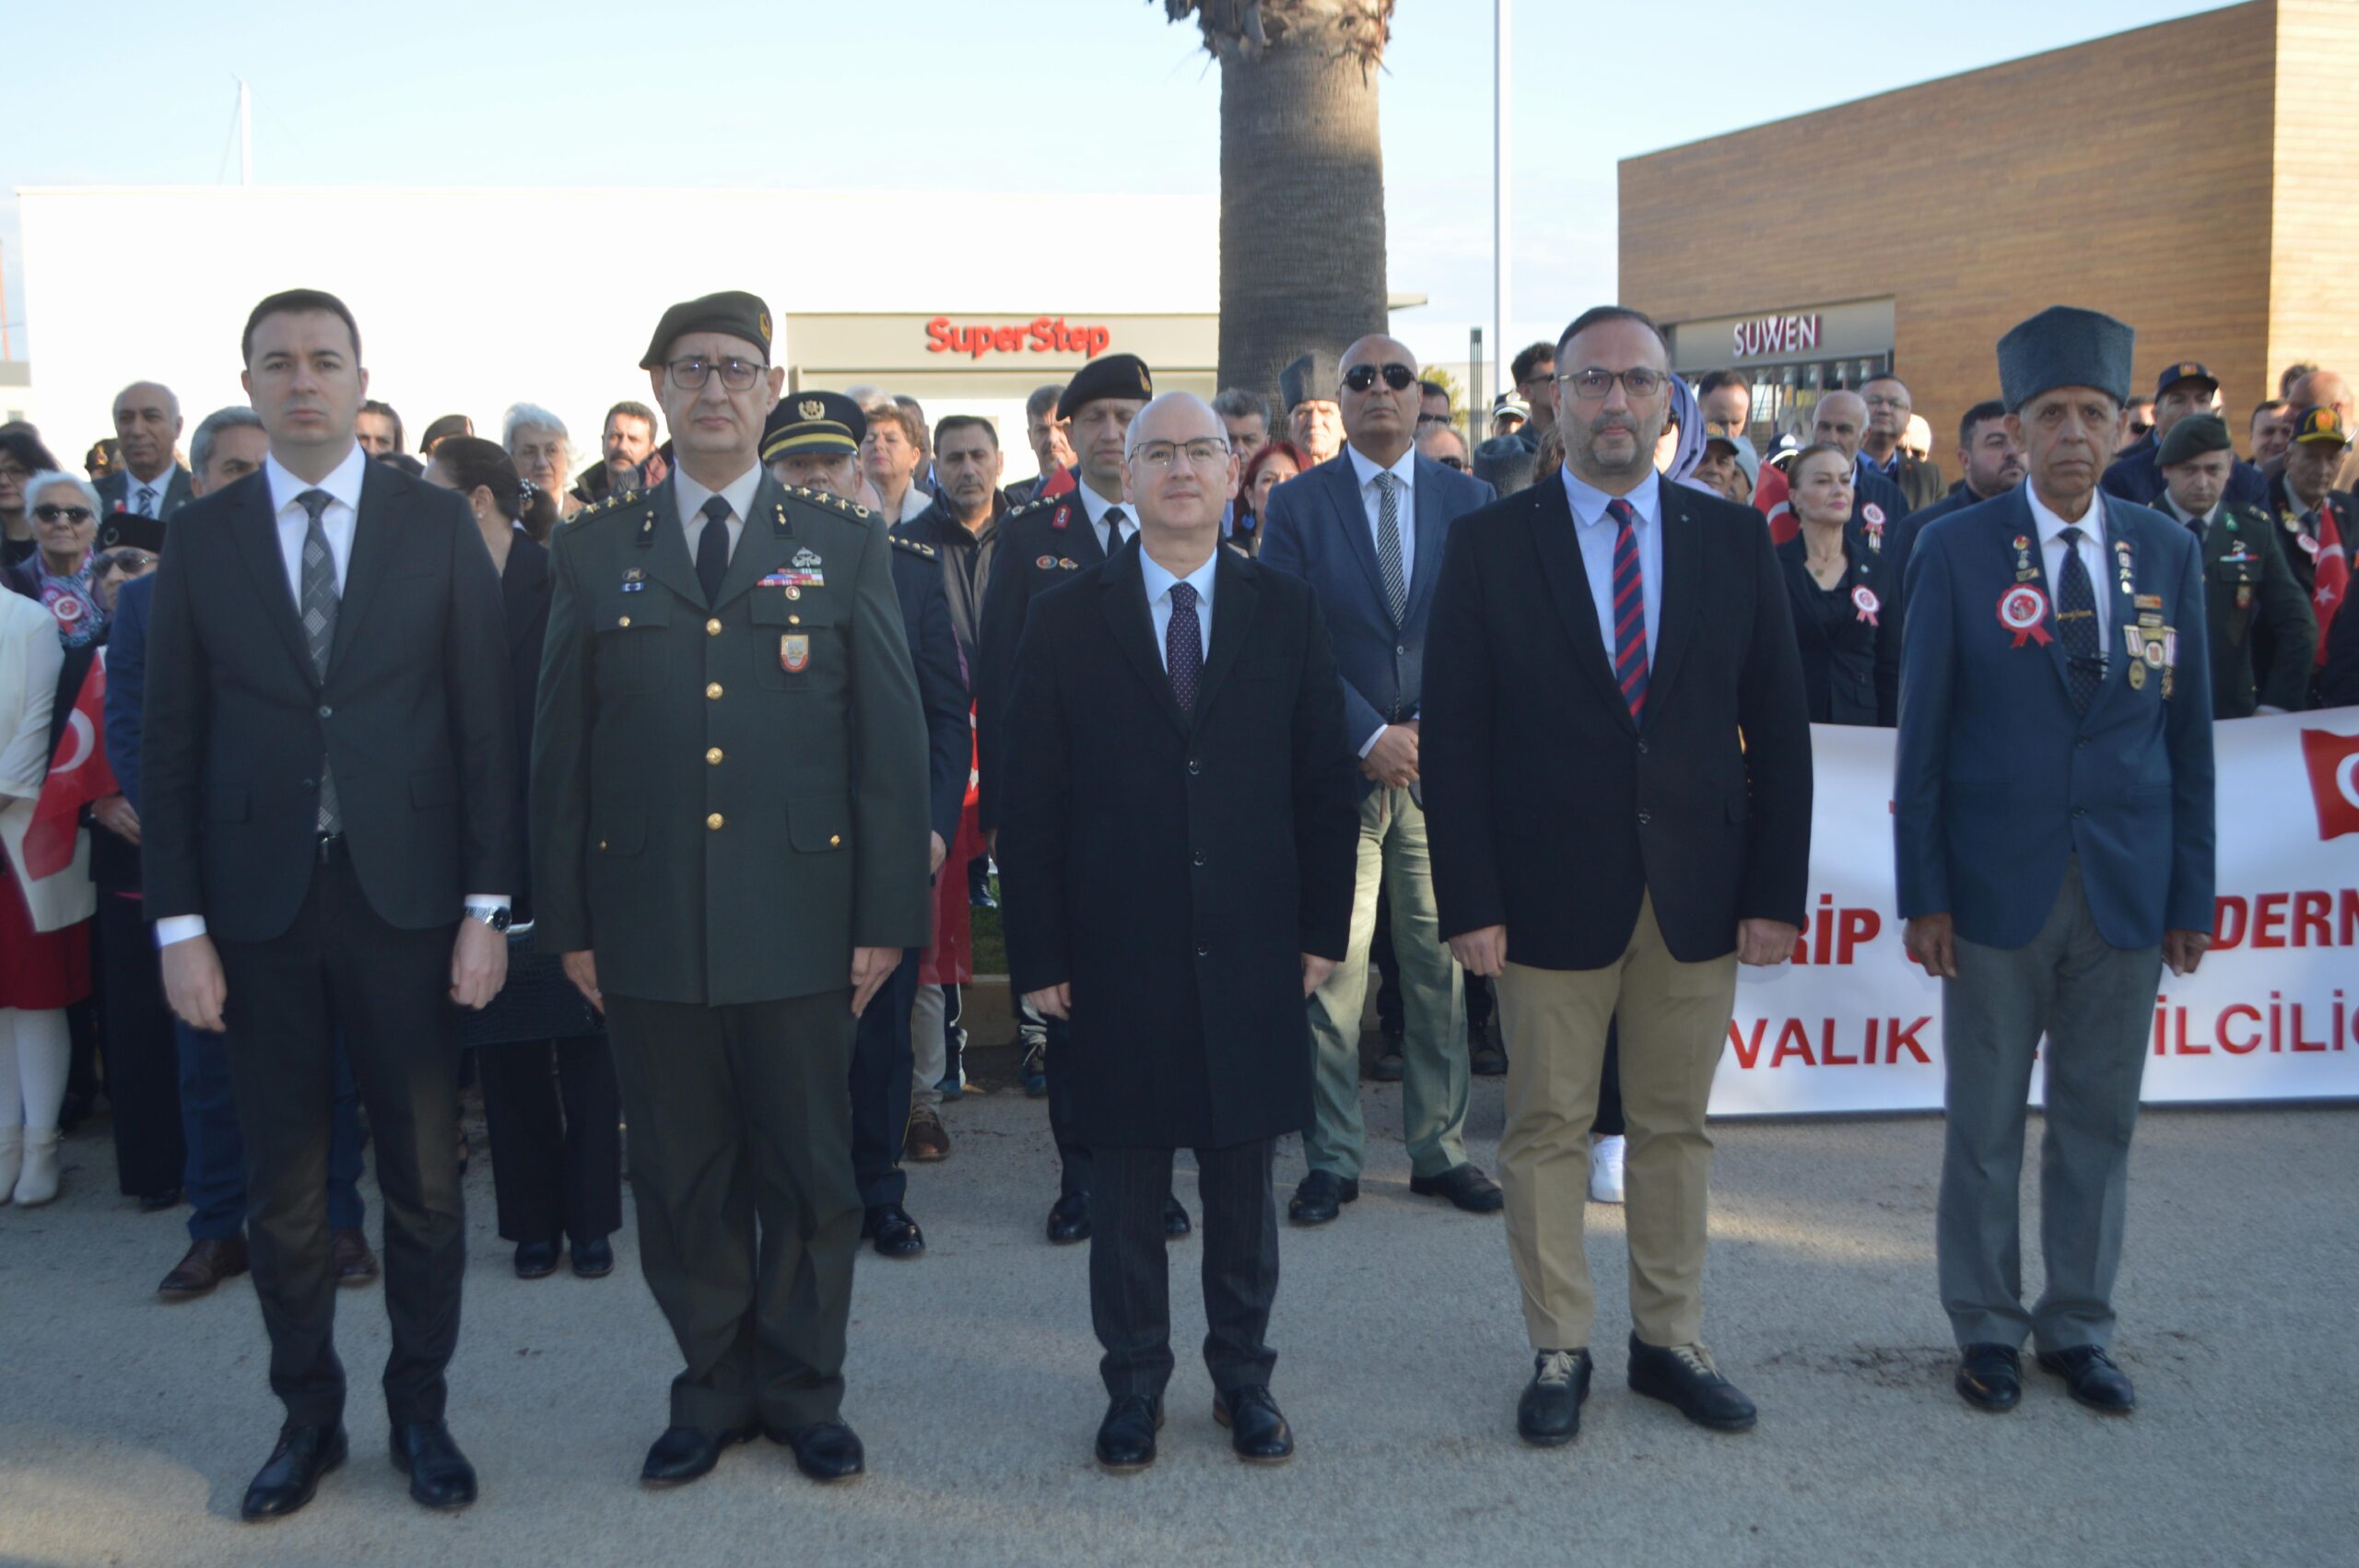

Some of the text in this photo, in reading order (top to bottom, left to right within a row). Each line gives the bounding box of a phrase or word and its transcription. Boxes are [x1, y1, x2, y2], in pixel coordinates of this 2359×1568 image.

[926, 316, 1109, 358] SuperStep
[1733, 313, 1818, 357] SUWEN
[1728, 989, 2359, 1069] VALIK İLCİLİ
